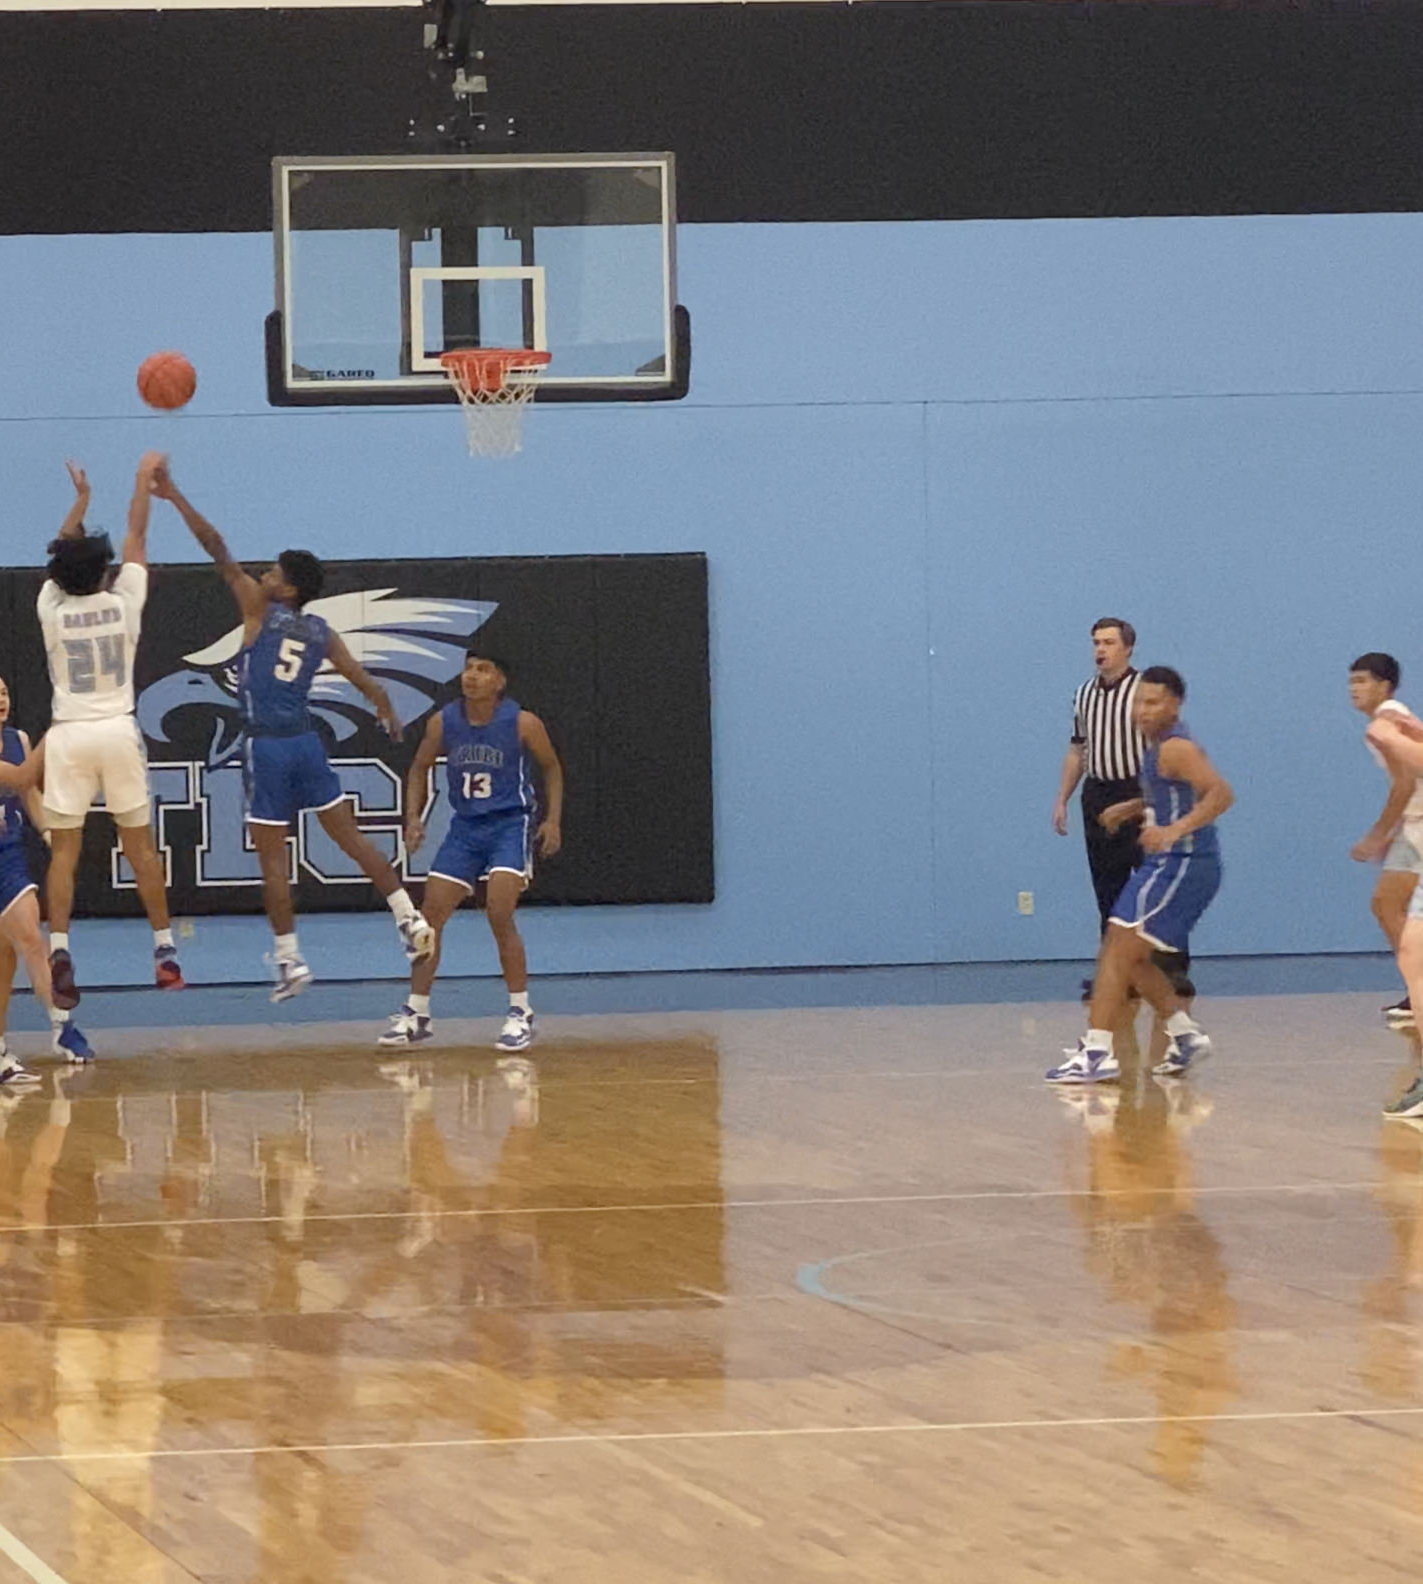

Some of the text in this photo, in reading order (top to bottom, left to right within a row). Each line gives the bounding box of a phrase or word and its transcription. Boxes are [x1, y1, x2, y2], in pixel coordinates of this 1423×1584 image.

[62, 633, 127, 694] 24
[273, 637, 306, 683] 5
[462, 771, 492, 799] 13
